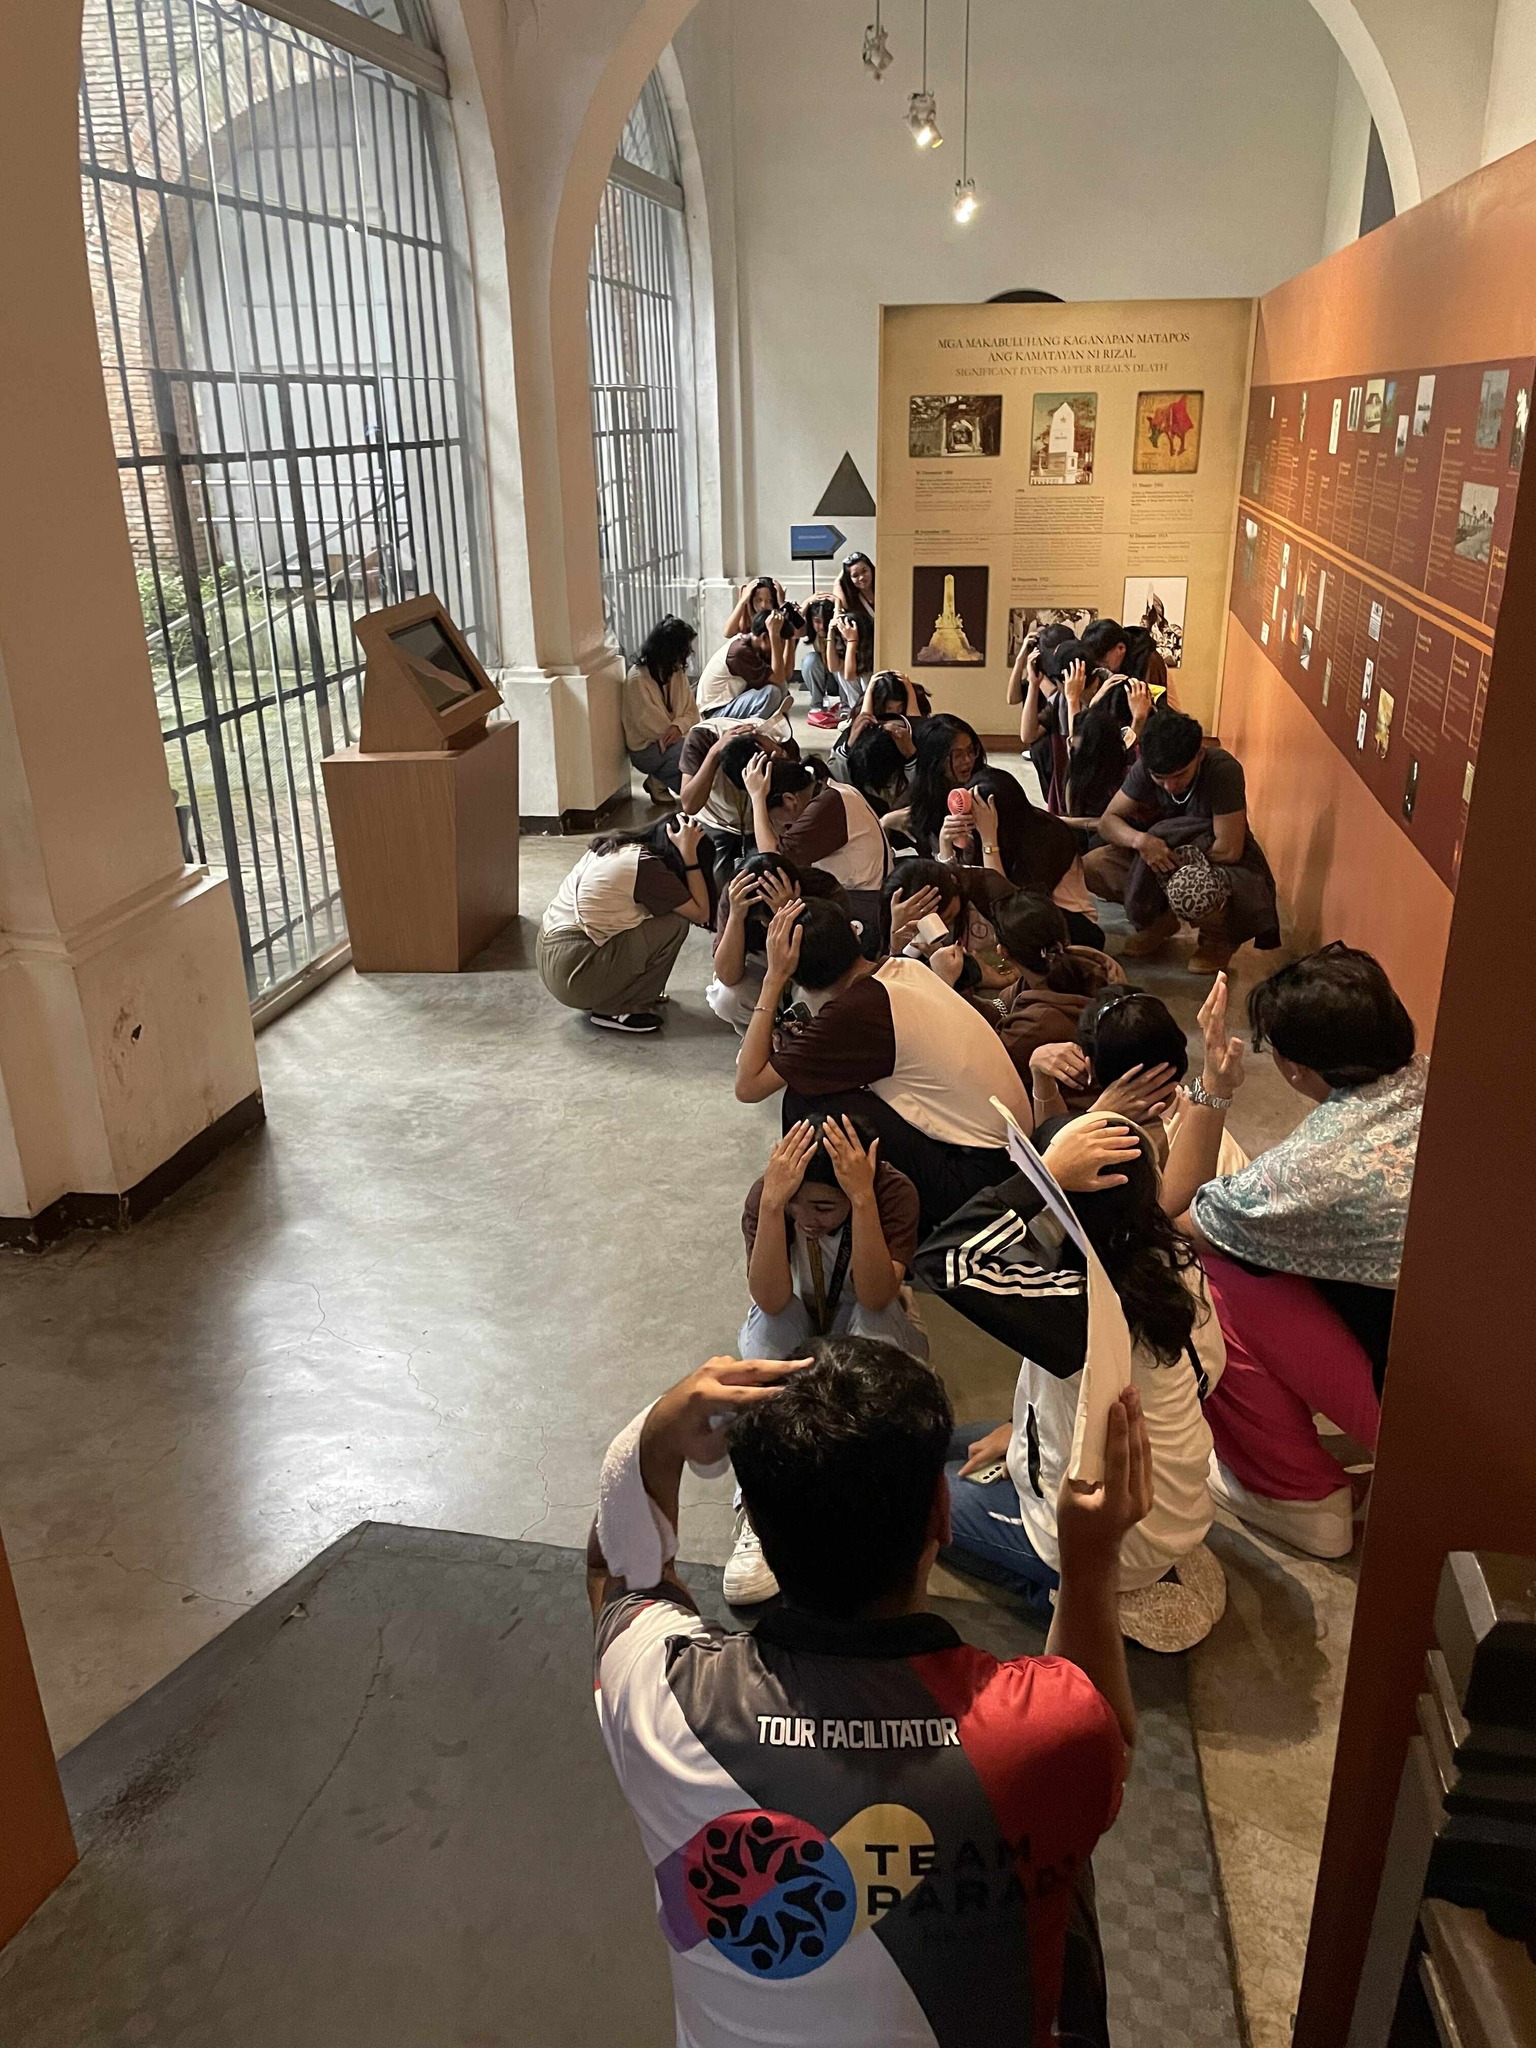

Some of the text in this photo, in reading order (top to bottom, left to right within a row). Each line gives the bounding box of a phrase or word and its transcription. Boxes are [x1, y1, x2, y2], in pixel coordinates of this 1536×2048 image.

[938, 332, 1190, 349] MGA MAKABULUHANG KAGANAPAN MATAPOS
[989, 348, 1136, 362] ANG KAMATAYAN NI RIZAL
[1020, 365, 1060, 376] EVENTS
[1061, 364, 1092, 375] AFTER
[1133, 362, 1168, 373] DEATH
[757, 1716, 961, 1749] TOUR FACILITATOR
[864, 1833, 1031, 1876] TEAM
